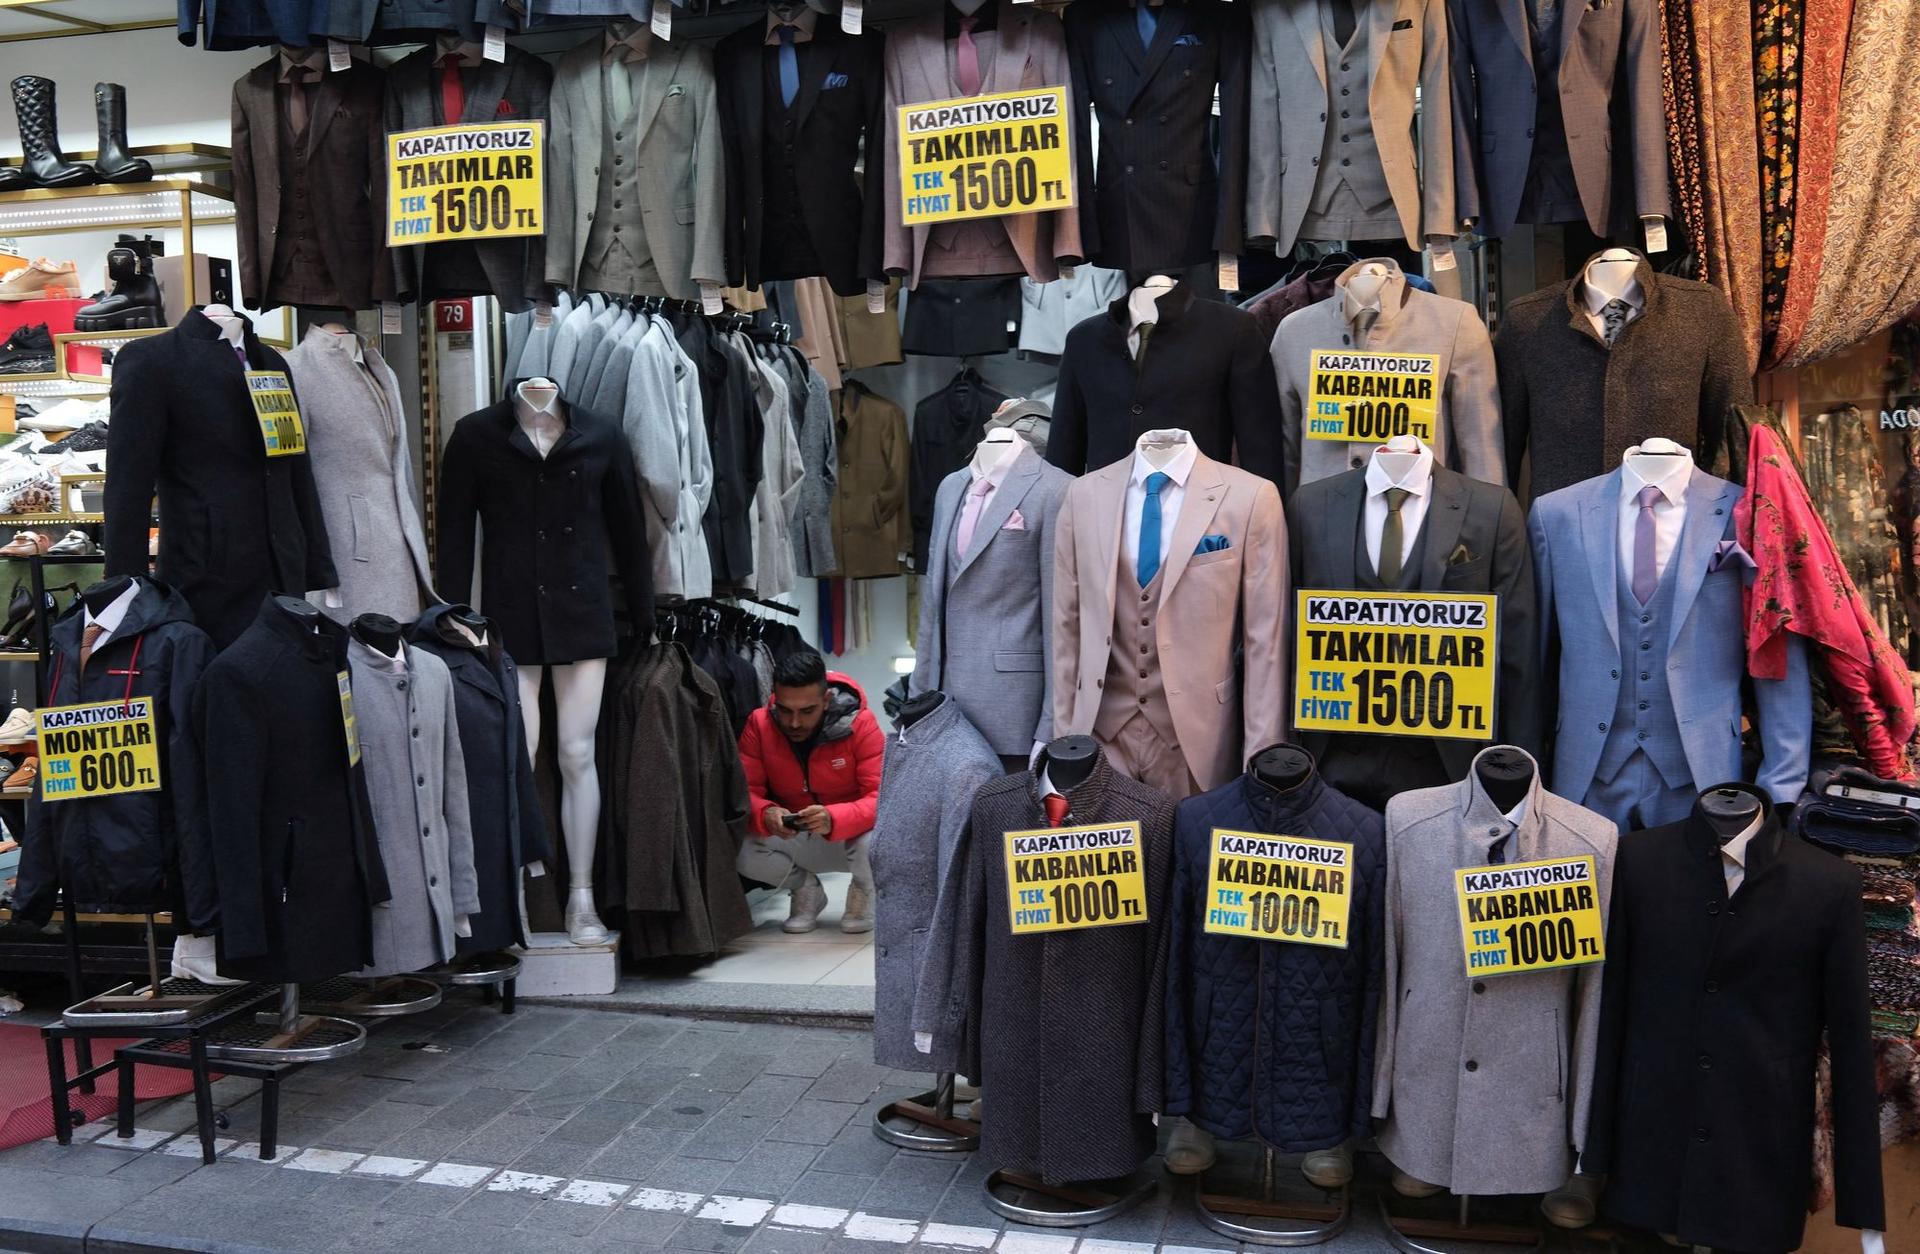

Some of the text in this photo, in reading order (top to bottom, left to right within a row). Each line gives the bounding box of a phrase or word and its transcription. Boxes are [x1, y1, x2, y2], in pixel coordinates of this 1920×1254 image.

[909, 97, 1055, 131] KAPATIYORUZ
[398, 131, 531, 157] KAPATIYORUZ
[908, 123, 1059, 165] TAKIMLAR
[397, 155, 533, 189] TAKIMLAR
[913, 170, 943, 190] TEK
[950, 156, 1066, 212] 1500 TL
[400, 195, 426, 213] TEK
[431, 185, 537, 233] 1500 TL
[907, 194, 951, 215] FİYAT
[394, 217, 432, 236] FİYAT
[444, 305, 464, 323] 79
[1319, 356, 1431, 372] KAPATIYORUZ
[1316, 374, 1431, 399] KABANLAR
[1317, 401, 1340, 415] TEK
[1345, 401, 1429, 439] 1000 TL
[1311, 417, 1344, 434] FİYAT
[1309, 600, 1483, 625] KAPATIYORUZ
[1306, 630, 1485, 667] TAKIMLAR
[1309, 671, 1345, 692] TEK
[1301, 696, 1352, 721] FİYAT
[1352, 669, 1486, 730] 1500 TL
[43, 703, 146, 728] KAPATIYORUZ
[44, 722, 151, 755] MONTLAR
[48, 759, 71, 774] TEK
[80, 750, 154, 791] 600 TL
[46, 777, 77, 793] FİYAT
[1014, 829, 1132, 854] KAPATIYORUZ
[1221, 837, 1344, 865] KAPATIYORUZ
[1015, 850, 1137, 883] KABANLAR
[1217, 858, 1345, 895] KABANLAR
[1465, 863, 1588, 891] KAPATIYORUZ
[1019, 889, 1045, 904] TEK
[1050, 879, 1141, 924] 1000 TL
[1217, 889, 1244, 906] TEK
[1466, 885, 1593, 923] KABANLAR
[1015, 908, 1051, 925] FİYAT
[1209, 908, 1248, 927] FİYAT
[1248, 891, 1341, 939] 1000 TL
[1472, 929, 1500, 945] TEK
[1504, 917, 1599, 966] 1000 TL
[1469, 949, 1507, 968] FİYAT
